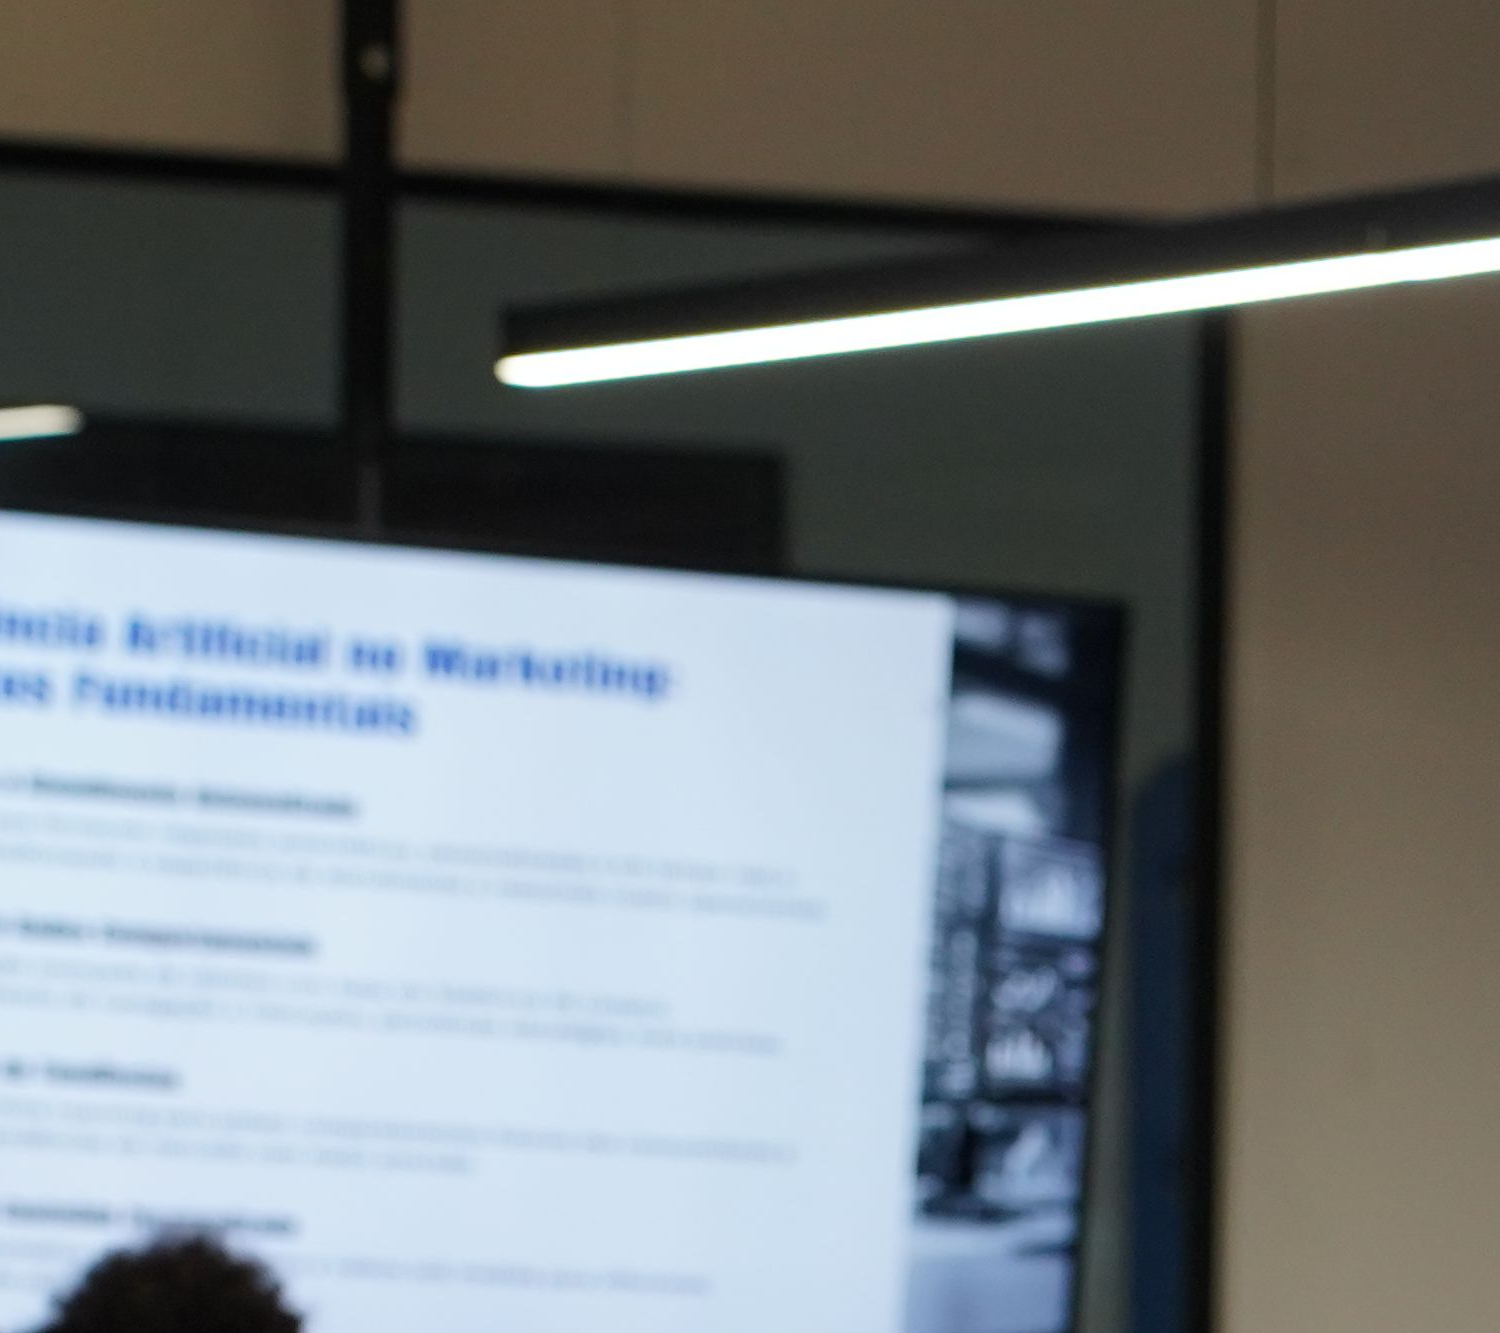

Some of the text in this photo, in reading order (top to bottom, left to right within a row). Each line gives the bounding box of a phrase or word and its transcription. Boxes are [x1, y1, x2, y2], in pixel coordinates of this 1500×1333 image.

[121, 613, 329, 670] Artificial
[344, 638, 405, 676] no
[71, 676, 417, 735] Fundamentais
